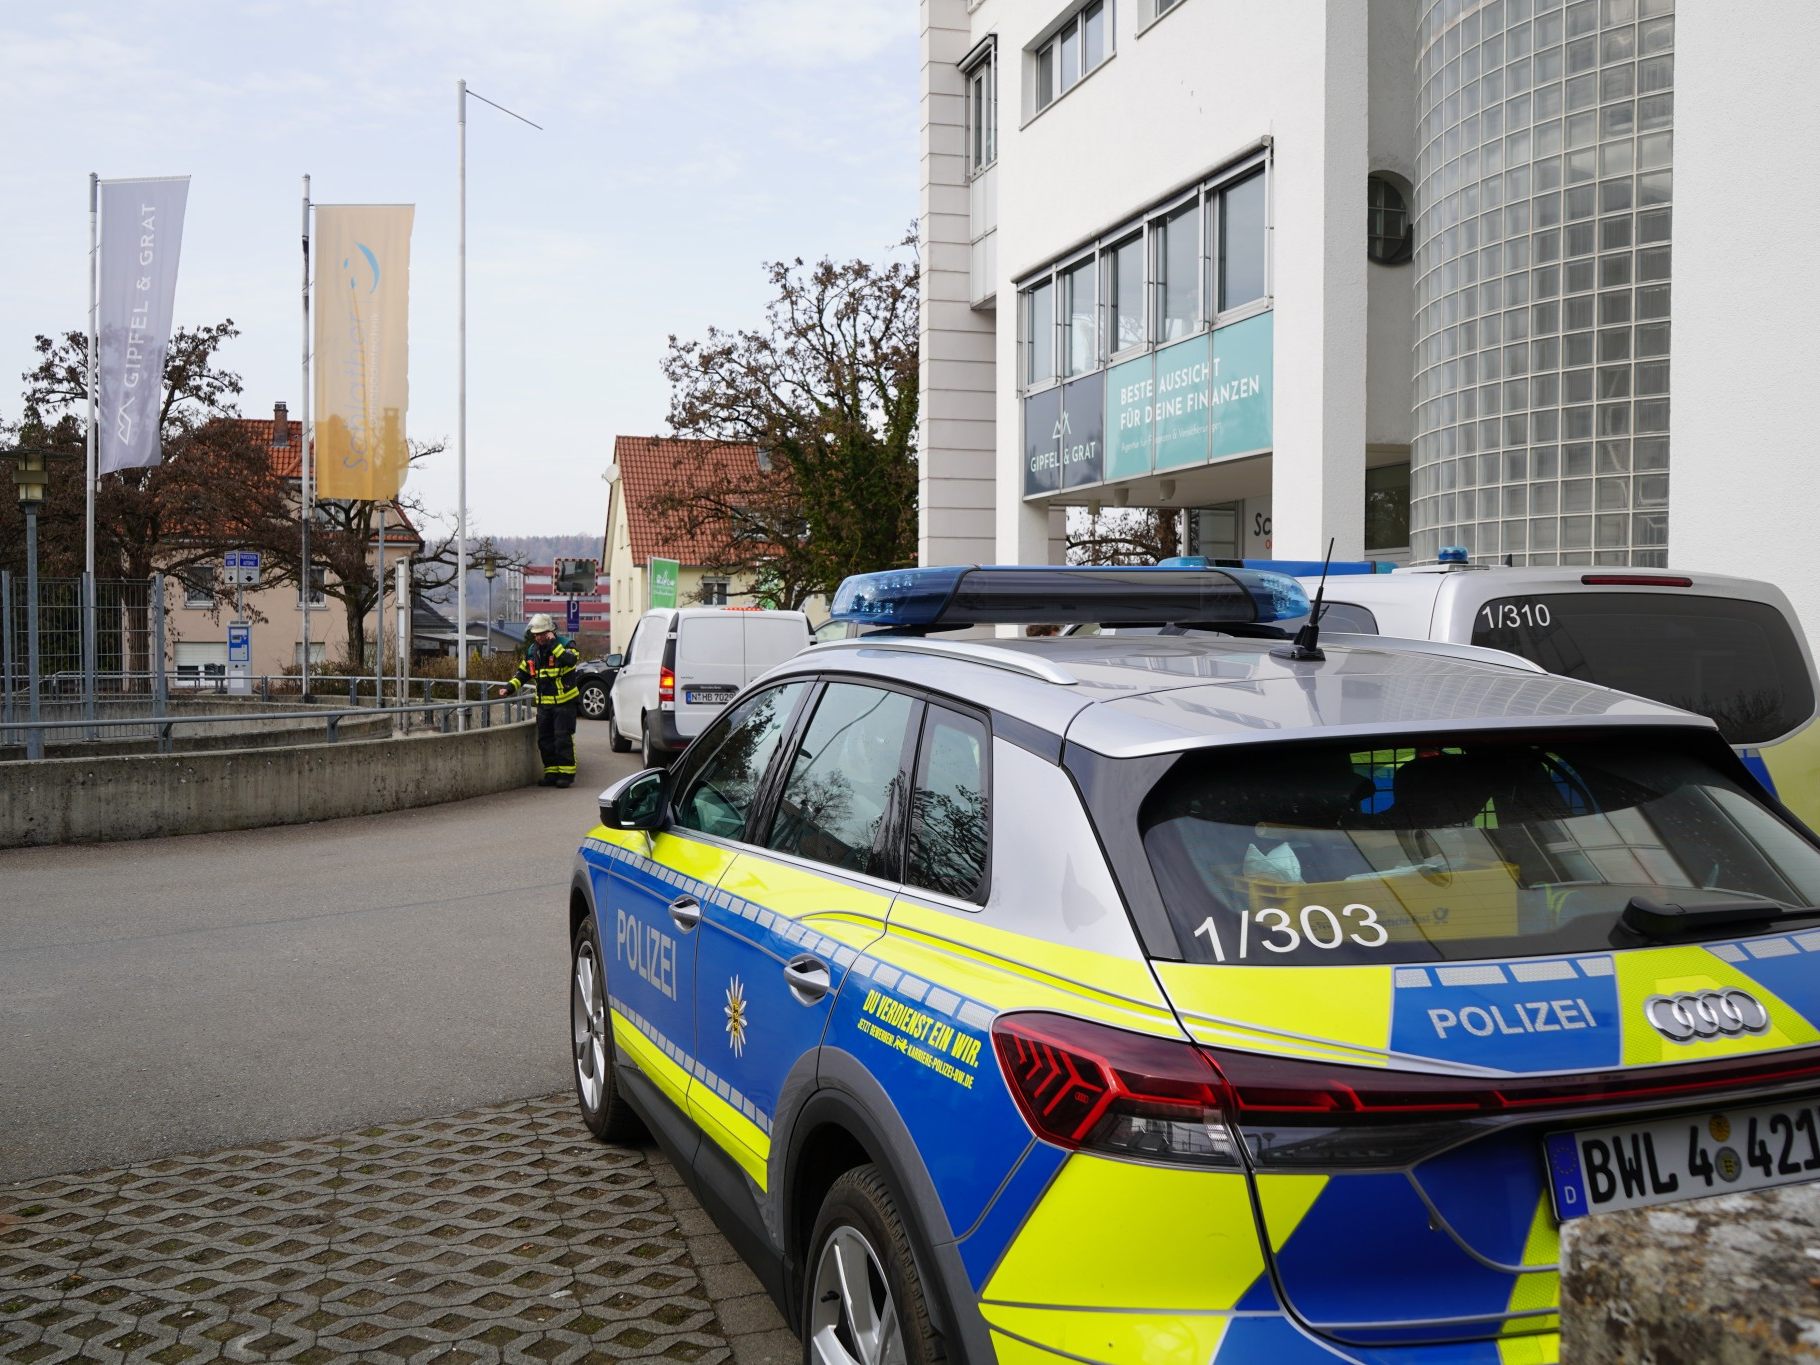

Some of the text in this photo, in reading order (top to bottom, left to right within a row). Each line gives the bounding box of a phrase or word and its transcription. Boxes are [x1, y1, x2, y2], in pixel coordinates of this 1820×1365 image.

[124, 203, 156, 387] GIPFEL & GRAT
[1120, 357, 1221, 406] BESTE AUSSICHT
[1120, 374, 1260, 431] FÜR DEINE FINANZEN
[1030, 441, 1096, 473] GIPFEL & GRAT
[1253, 512, 1273, 537] Sc
[570, 601, 578, 619] P
[1481, 603, 1551, 630] 1/310
[618, 909, 677, 1002] POLIZEI
[1193, 903, 1388, 962] 1/303
[863, 989, 982, 1068] DU VERDIENST EIN WIR.
[1427, 998, 1596, 1040] POLIZEI
[1581, 1131, 1679, 1204] BWL
[1746, 1108, 1820, 1178] 421
[1564, 1185, 1577, 1205] D
